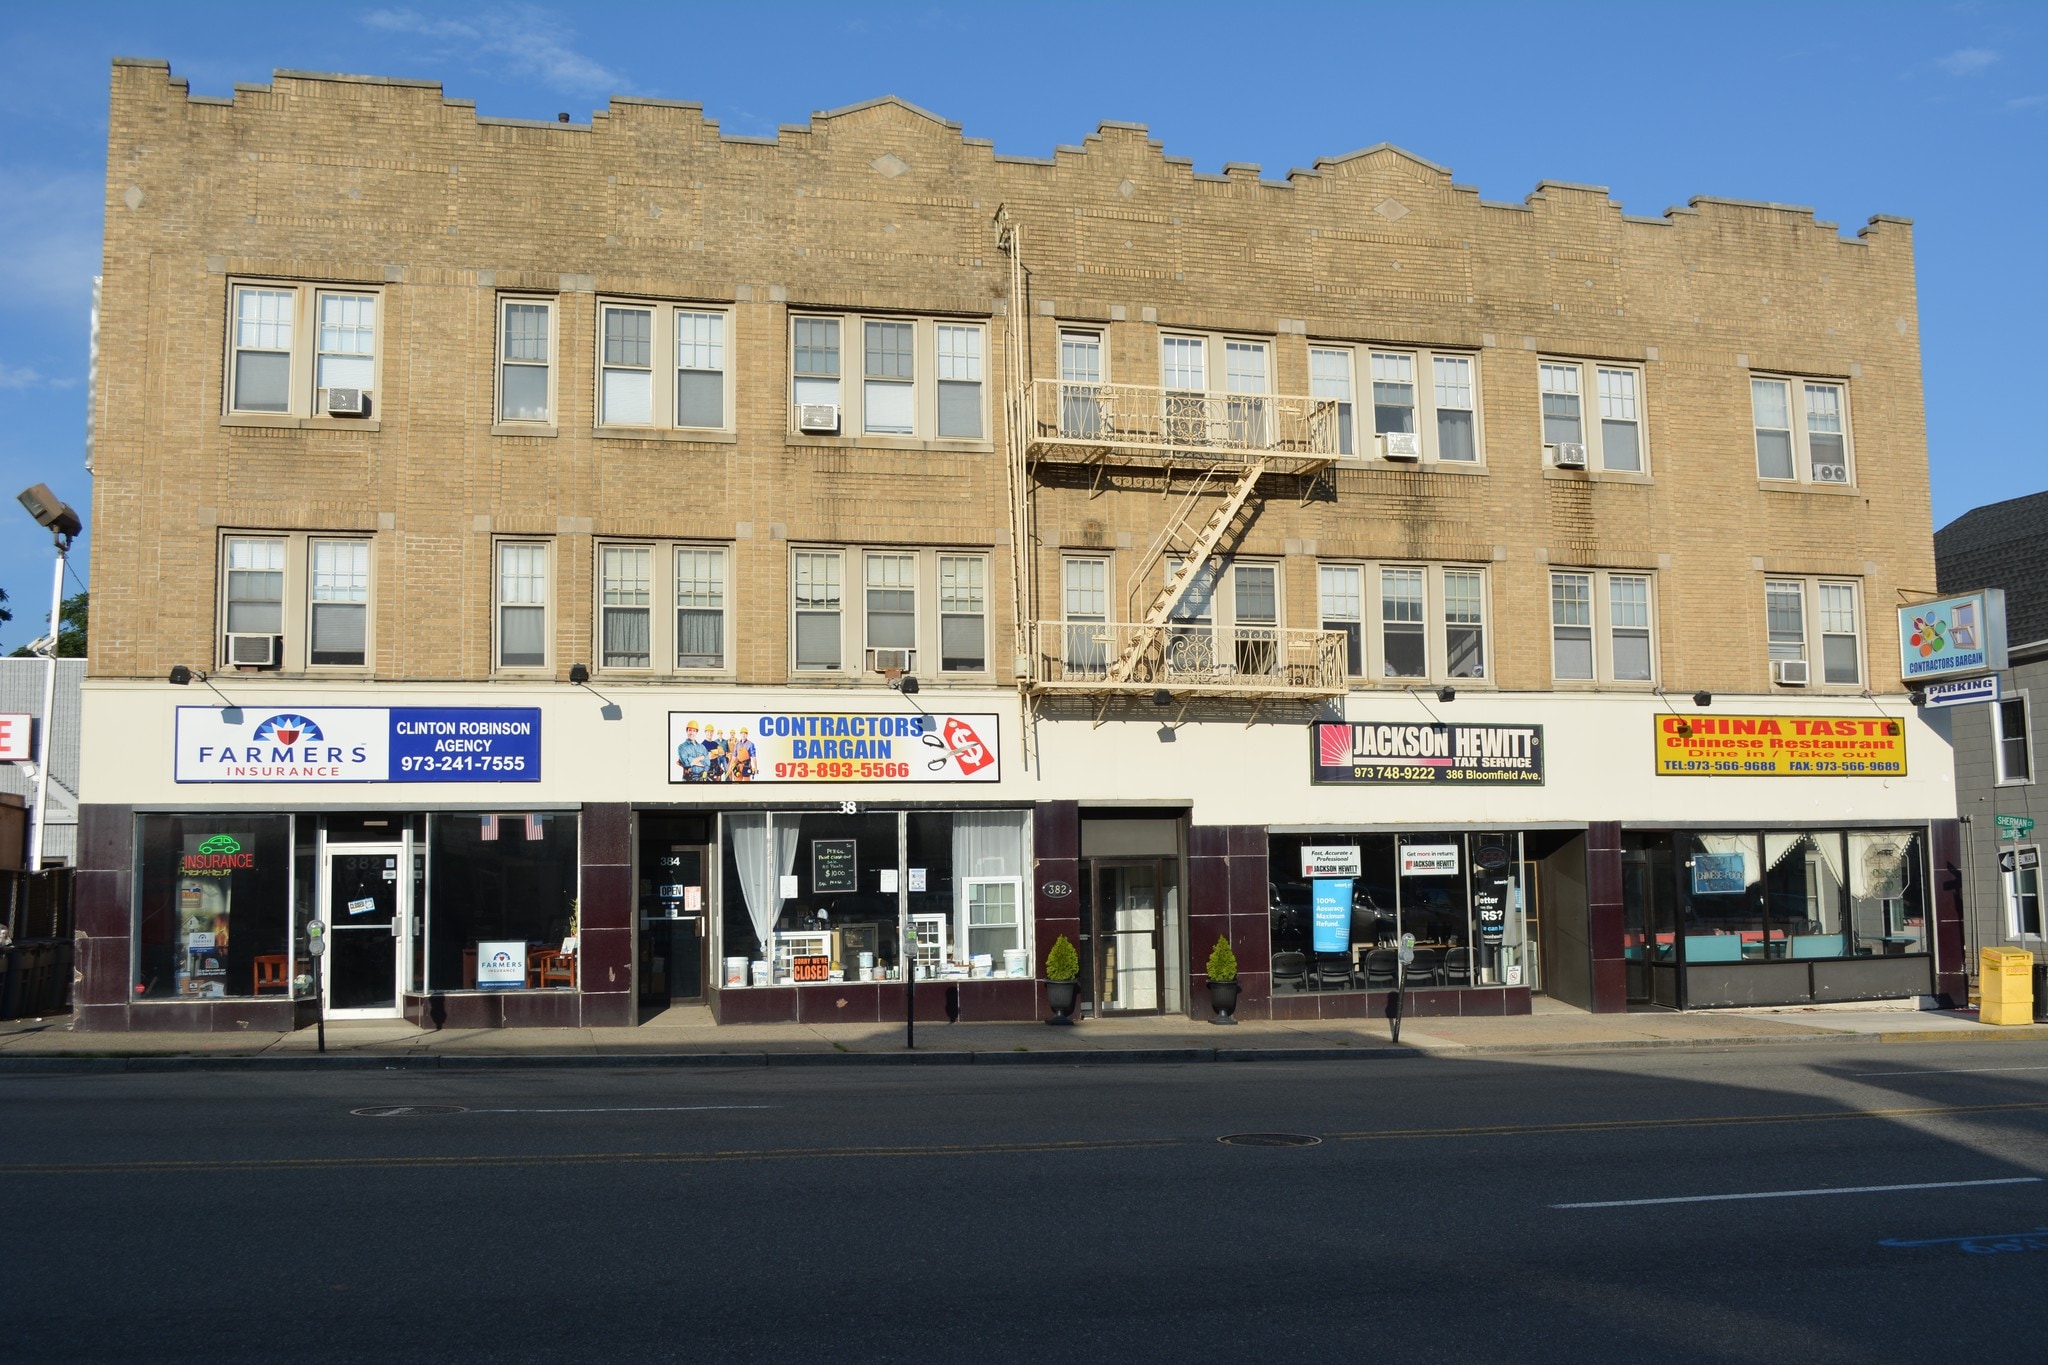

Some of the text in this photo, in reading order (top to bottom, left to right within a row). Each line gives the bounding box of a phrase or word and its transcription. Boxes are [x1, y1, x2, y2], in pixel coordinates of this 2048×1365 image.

[1909, 652, 1983, 674] CONTRACTORS BARGAIN
[1929, 680, 1992, 694] PARKING
[396, 722, 530, 735] CLINTON ROBINSON
[759, 716, 924, 737] CONTRACTORS
[1663, 718, 1900, 736] CHINA TASTE
[434, 739, 492, 752] AGENCY
[1354, 726, 1534, 758] JACKSON HEWITT
[1666, 737, 1894, 750] Chinese Restaurant
[200, 747, 366, 763] FARMERS
[793, 739, 892, 760] BARGAIN
[1688, 750, 1738, 758] Dine
[1746, 750, 1762, 758] in
[1772, 750, 1778, 758] /
[1786, 750, 1835, 758] Take
[401, 756, 525, 771] 973-241-7555
[1453, 757, 1532, 768] TAX SERVICE
[1790, 760, 1813, 770] FAX:
[1816, 761, 1900, 771] 973-566-9689
[227, 766, 340, 776] INSURANCE
[775, 762, 910, 778] 973-893-5566
[1354, 767, 1435, 780] 973 748-9222
[1446, 770, 1541, 780] 386 Bloomfield Ave.
[1998, 816, 2028, 827] SHERMAN
[184, 853, 254, 869] INSURANCE
[346, 857, 380, 870] 382
[660, 857, 680, 866] 384
[662, 886, 682, 896] OPEN
[1048, 884, 1066, 894] 382
[1481, 910, 1503, 920] RS?
[794, 965, 828, 980] CLOSED
